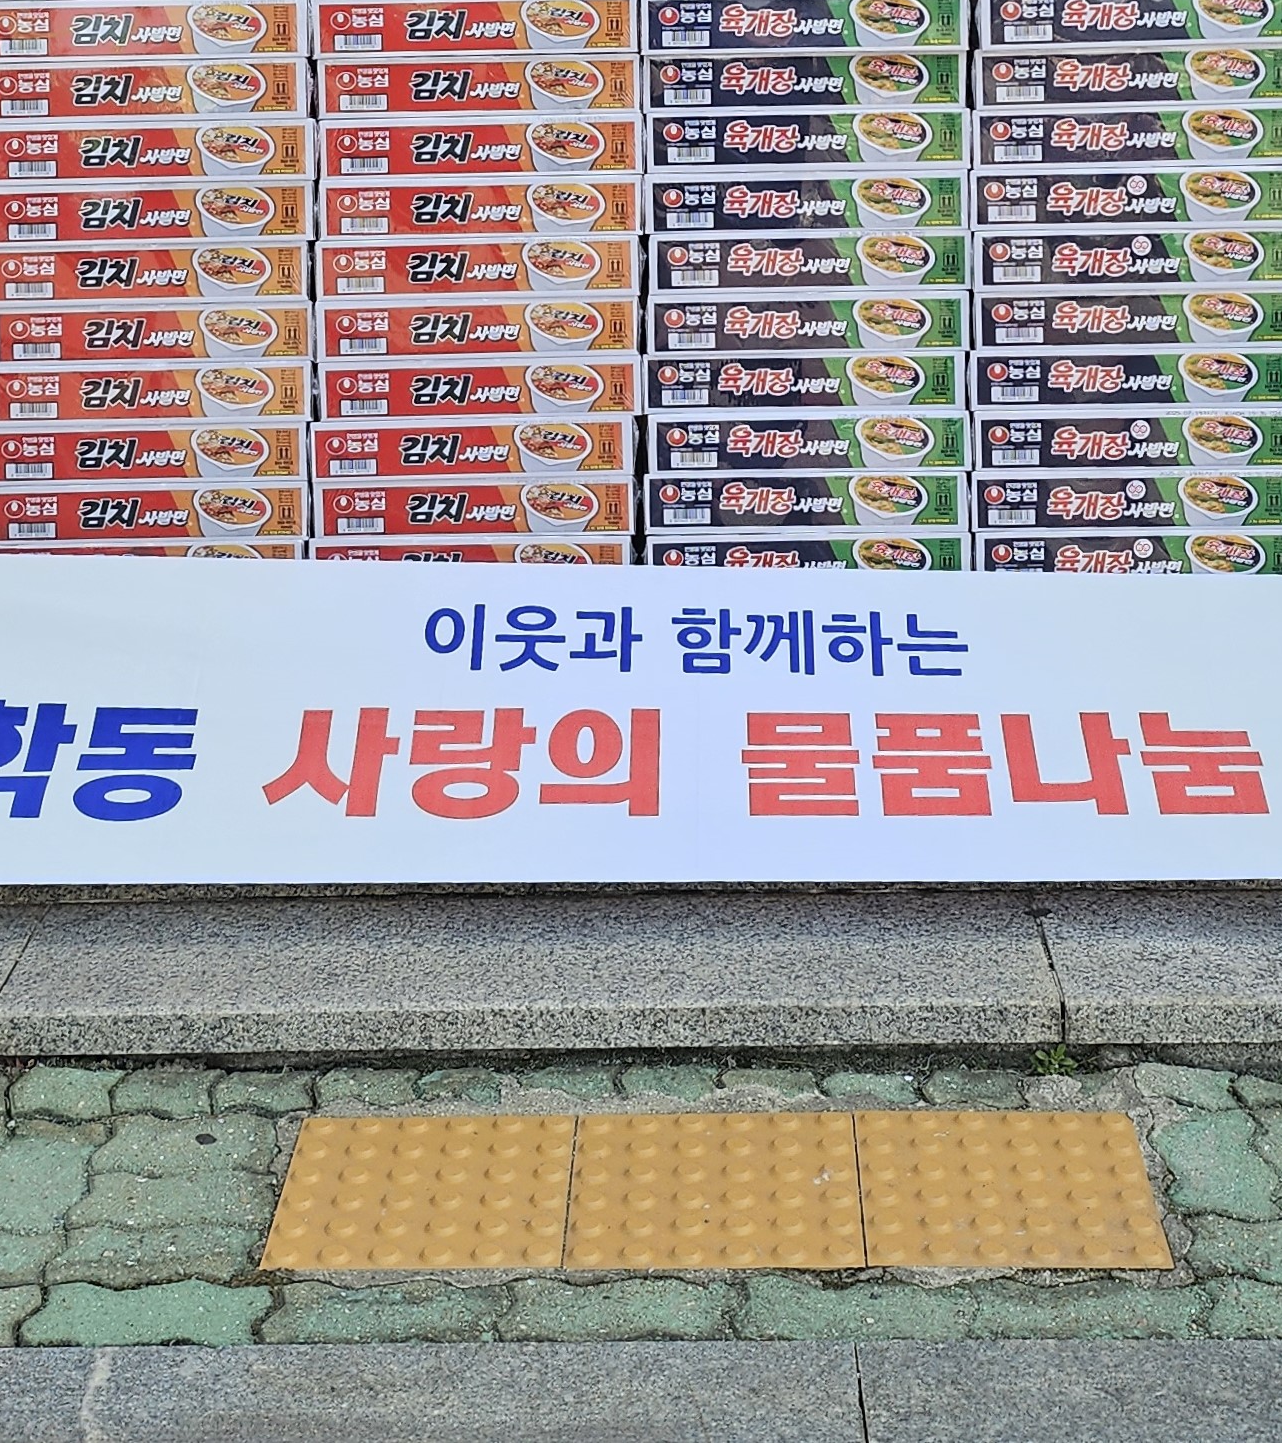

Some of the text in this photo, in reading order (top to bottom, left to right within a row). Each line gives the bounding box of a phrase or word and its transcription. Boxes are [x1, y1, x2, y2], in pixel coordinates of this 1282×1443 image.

[351, 9, 518, 42] 농심 김치 사발면
[680, 3, 846, 38] 농심 육개장 사발면
[1022, 3, 1055, 19] 농심
[1136, 11, 1190, 30] 사발면
[1011, 242, 1182, 277] 농심 육개장 사발면
[356, 312, 523, 345] 농심 김치 사발면
[685, 305, 850, 340] 농심 육개장 사발면
[25, 497, 191, 530] 농심 김치 사발면
[423, 604, 970, 678] 이웃과 함께하는
[260, 705, 661, 822] 사랑의
[740, 709, 1270, 818] 물품나눔
